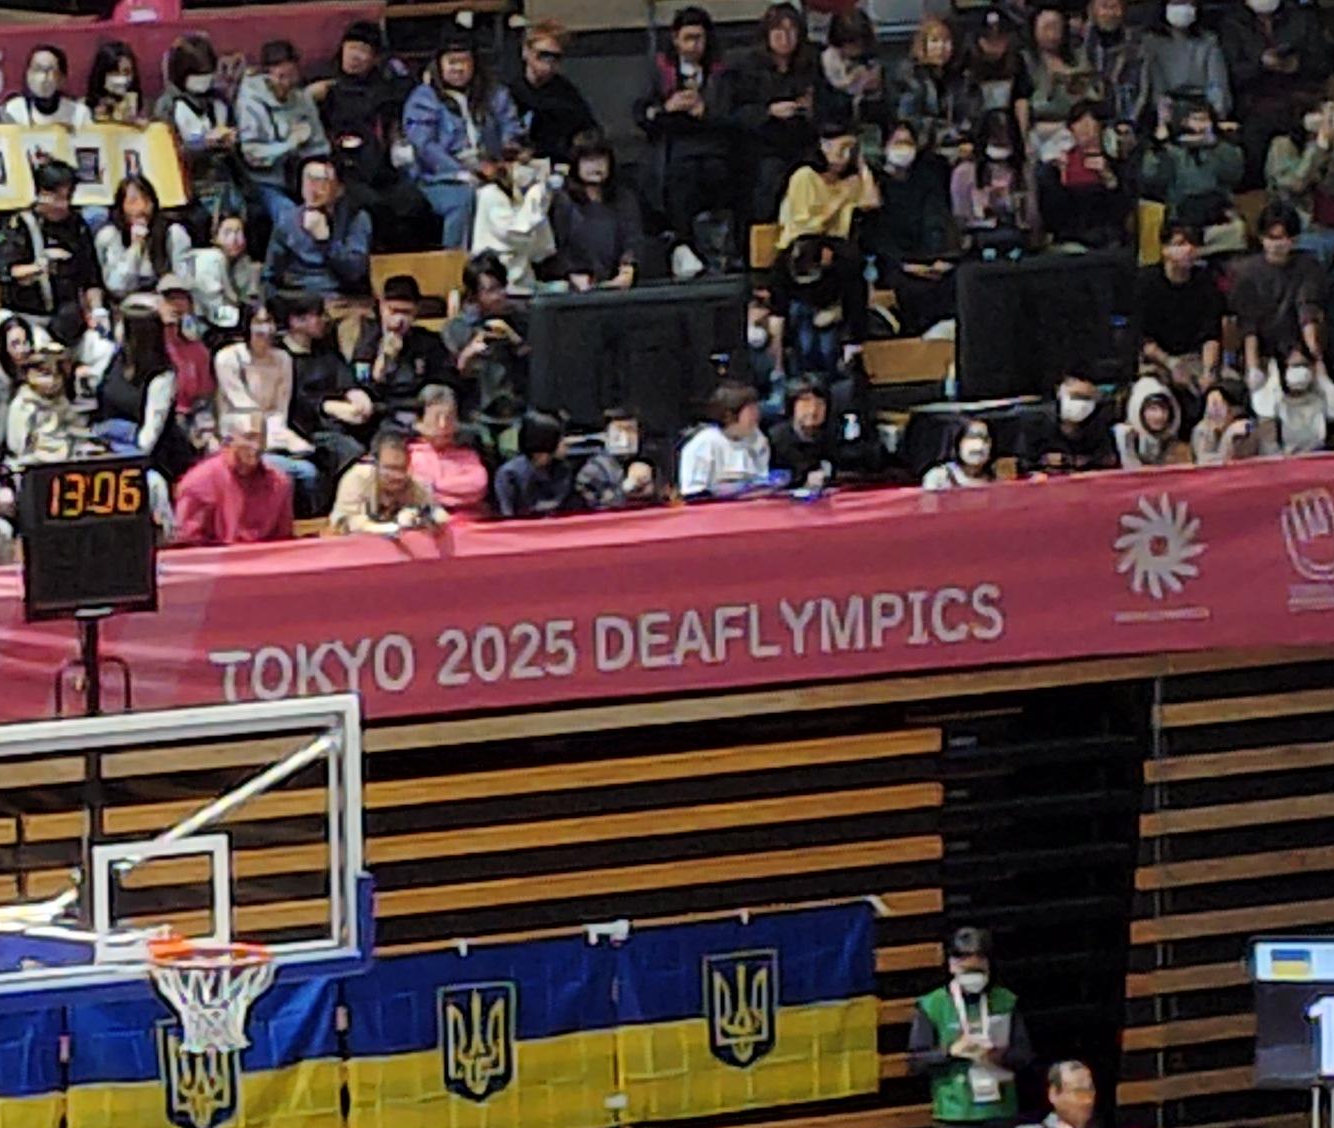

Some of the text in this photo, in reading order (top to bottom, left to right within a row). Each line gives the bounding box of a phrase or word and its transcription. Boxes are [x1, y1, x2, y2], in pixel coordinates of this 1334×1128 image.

[208, 583, 1006, 703] TOKYO 2025 DEAFLYMPICS
